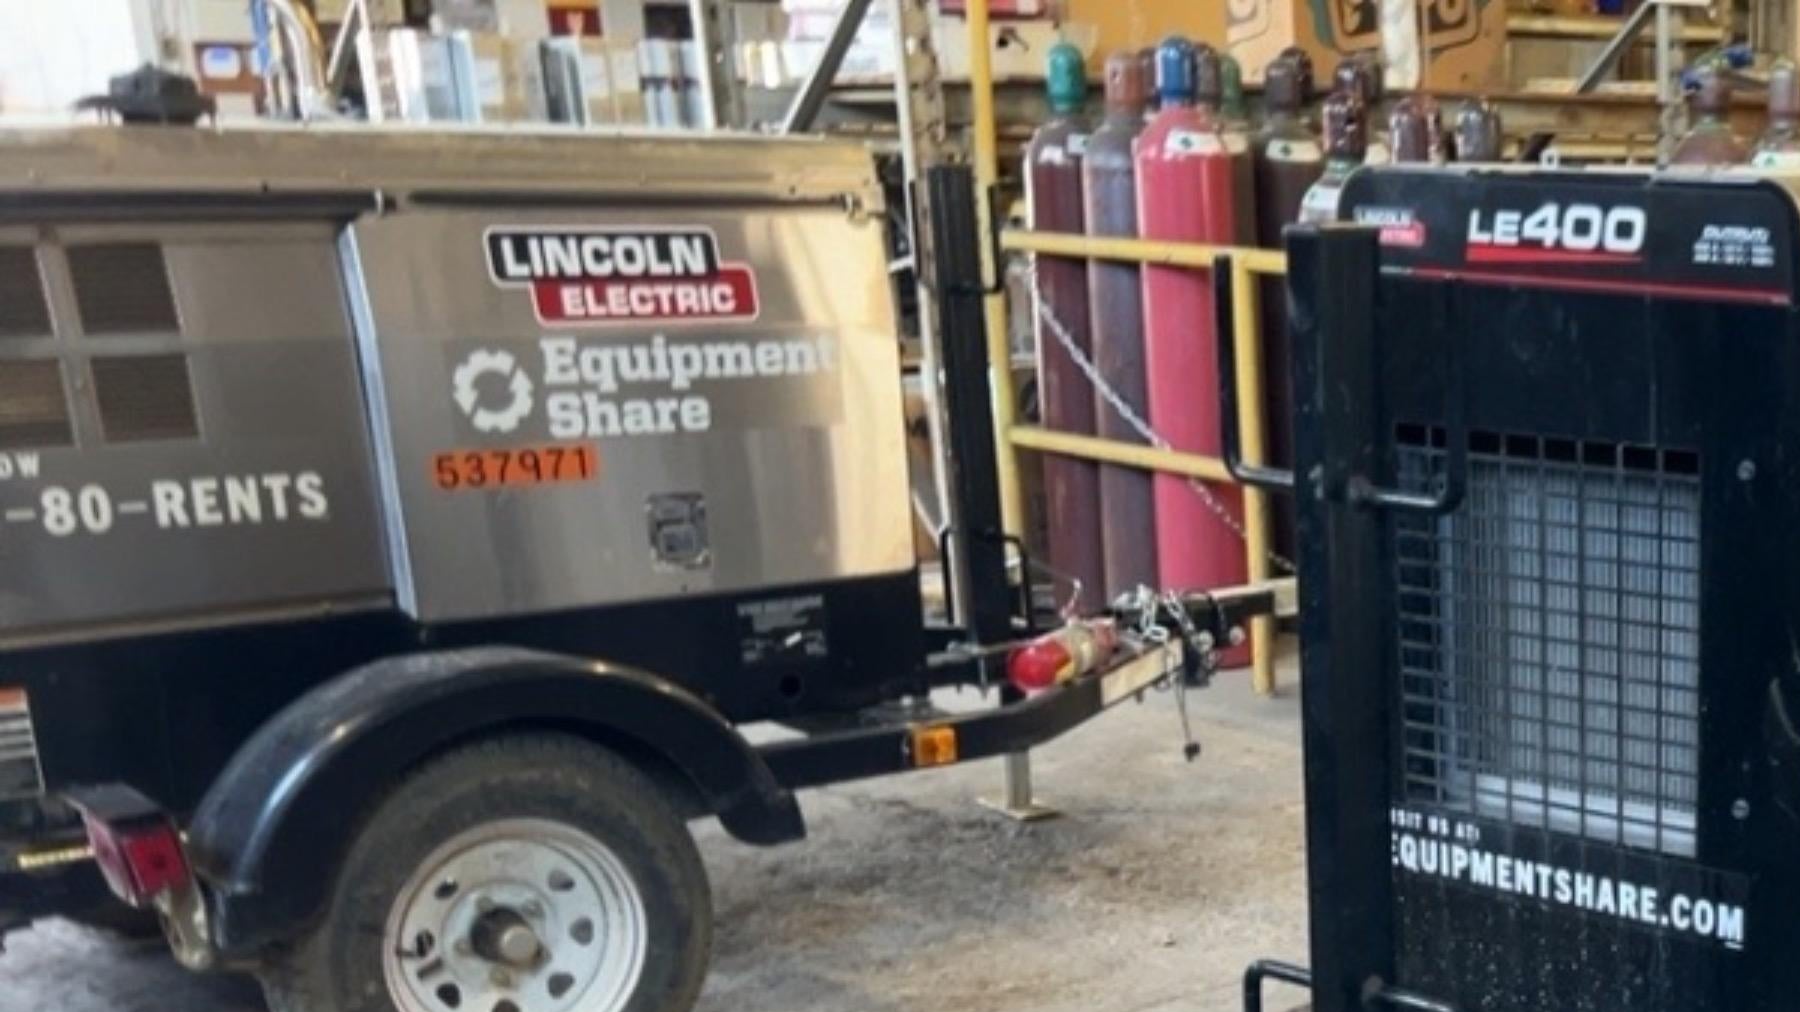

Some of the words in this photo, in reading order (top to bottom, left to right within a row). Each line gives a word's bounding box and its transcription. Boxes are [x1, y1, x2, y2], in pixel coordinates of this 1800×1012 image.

[1467, 202, 1646, 254] LE400
[500, 236, 706, 278] LINCOLN
[560, 283, 736, 318] ELECTRIC
[539, 335, 836, 392] Equipment
[546, 391, 711, 438] Share
[434, 446, 590, 490] 537971
